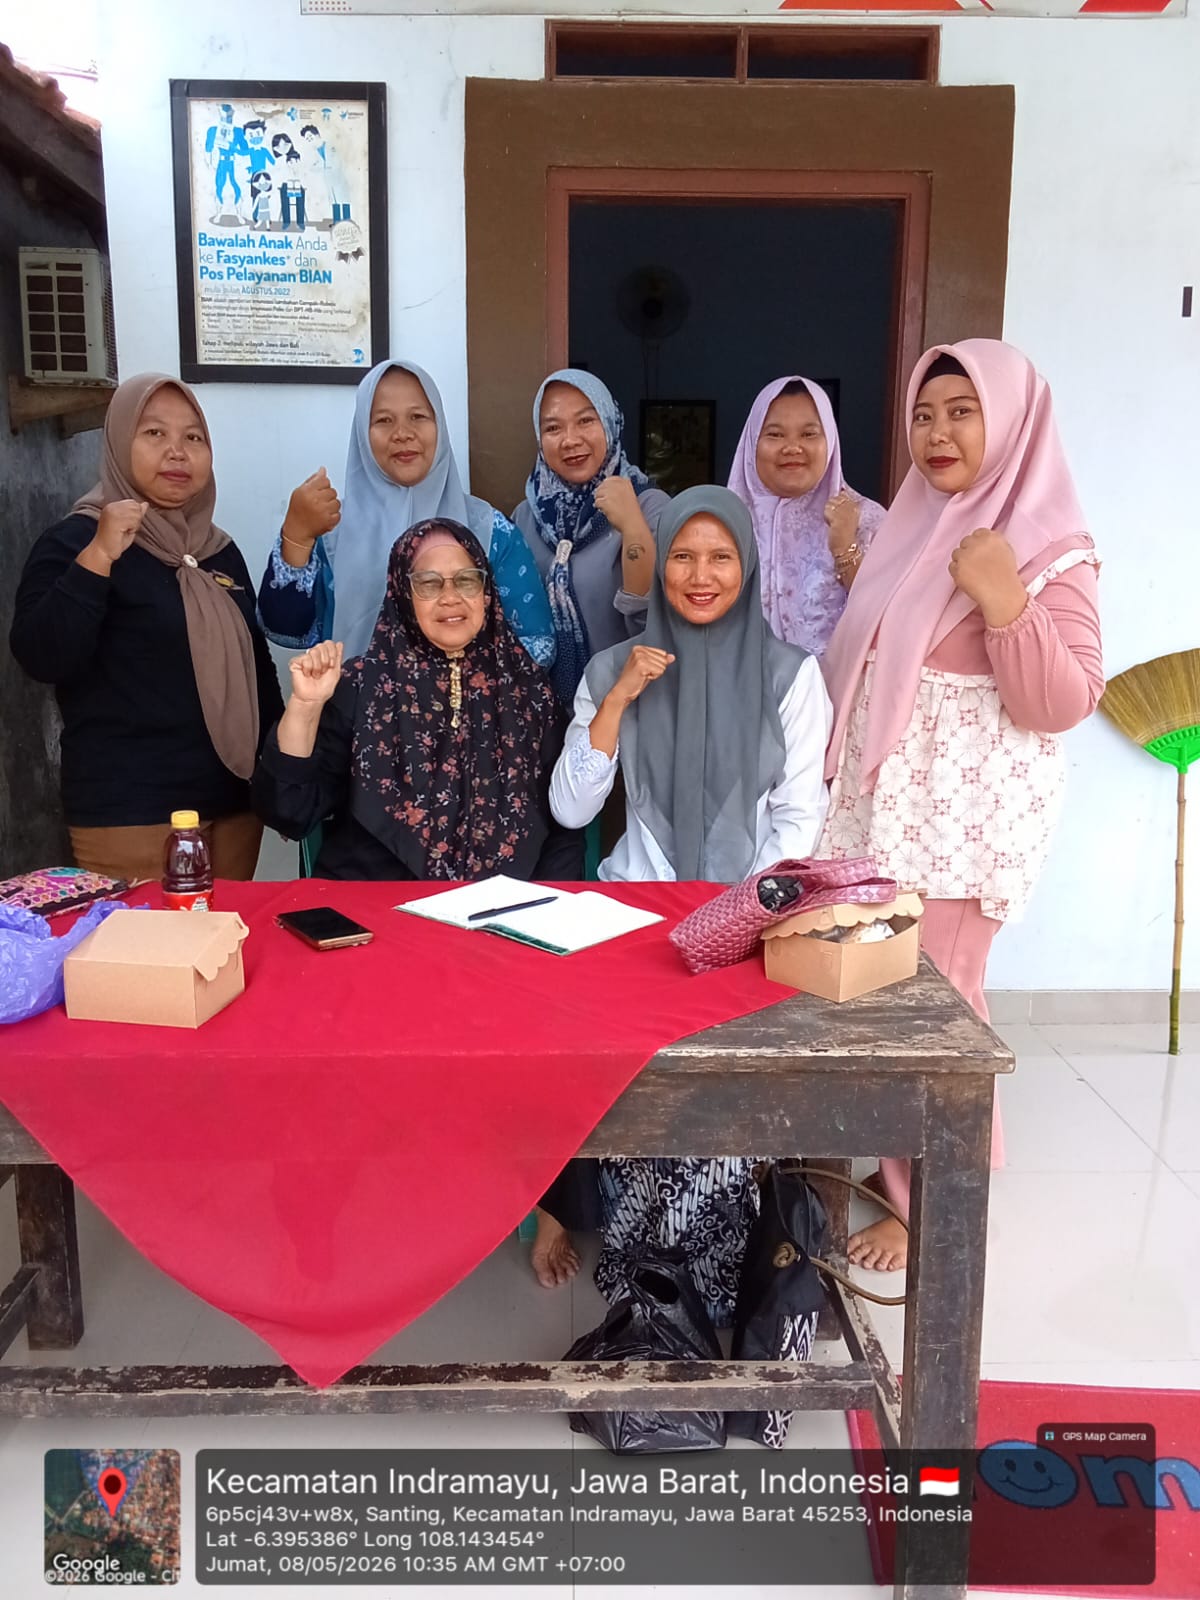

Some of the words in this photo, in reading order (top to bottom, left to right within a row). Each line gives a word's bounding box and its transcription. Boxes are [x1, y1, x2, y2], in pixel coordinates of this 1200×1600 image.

[198, 232, 256, 249] Bawalah
[258, 234, 293, 250] Anak
[296, 236, 328, 251] Anda
[199, 248, 214, 264] ke
[295, 252, 318, 267] dan
[200, 266, 224, 280] Pos
[227, 266, 296, 285] Pelayanan
[299, 269, 332, 284] BIAN
[241, 285, 272, 296] AGUSTUS
[274, 287, 291, 296] 2022
